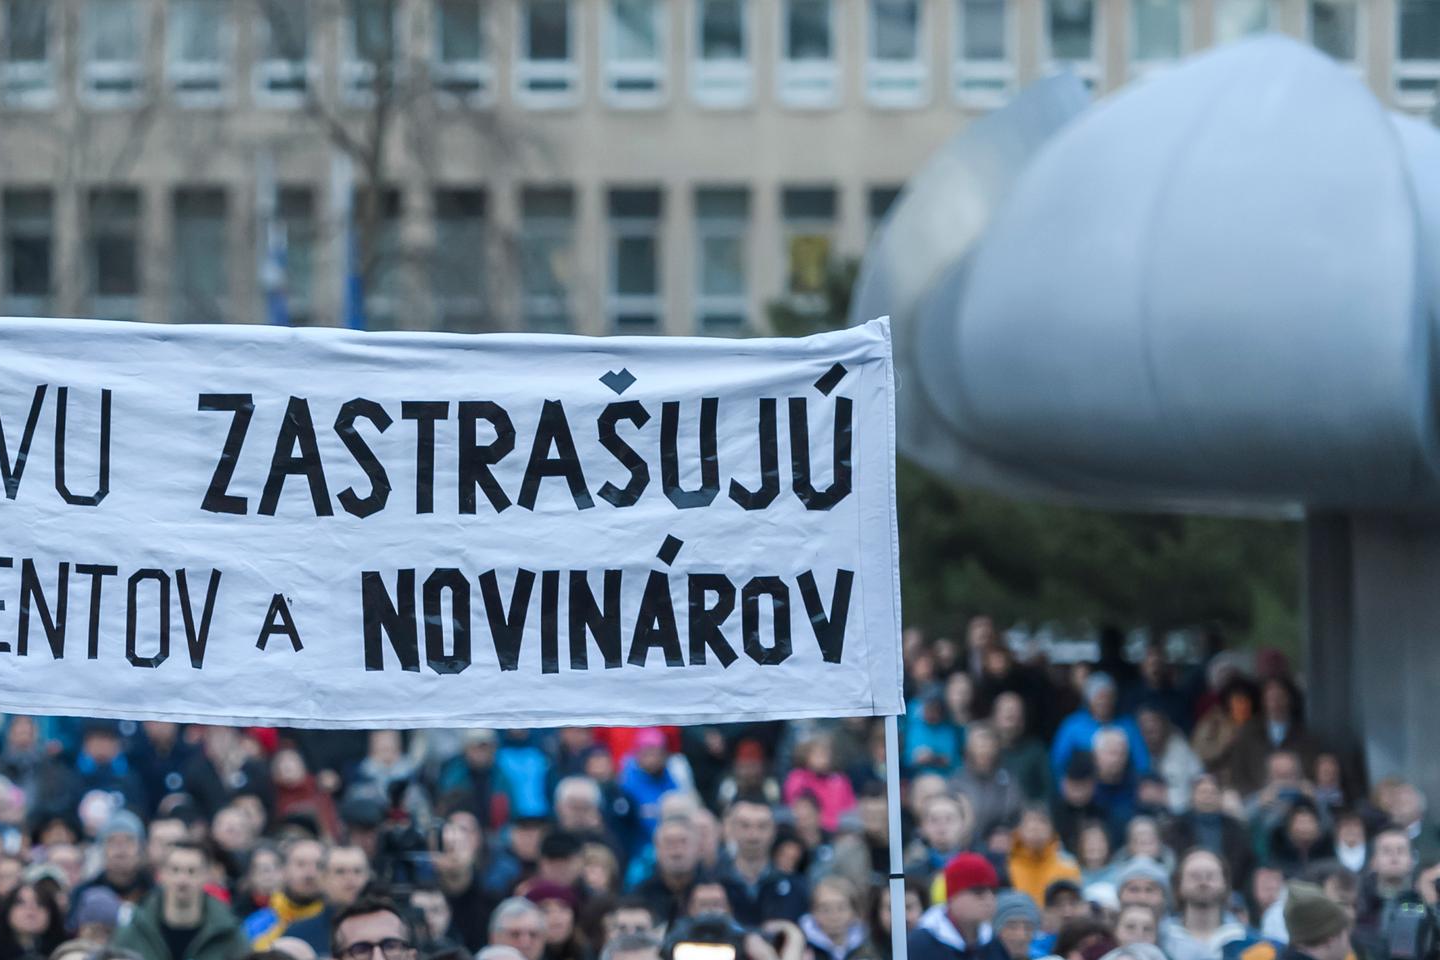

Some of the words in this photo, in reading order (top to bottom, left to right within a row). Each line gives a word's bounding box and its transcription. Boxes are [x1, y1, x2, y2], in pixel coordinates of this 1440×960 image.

[197, 361, 853, 520] ZASTRAŠUJÚ
[255, 593, 304, 653] A
[361, 533, 855, 676] NOVINÁROV
